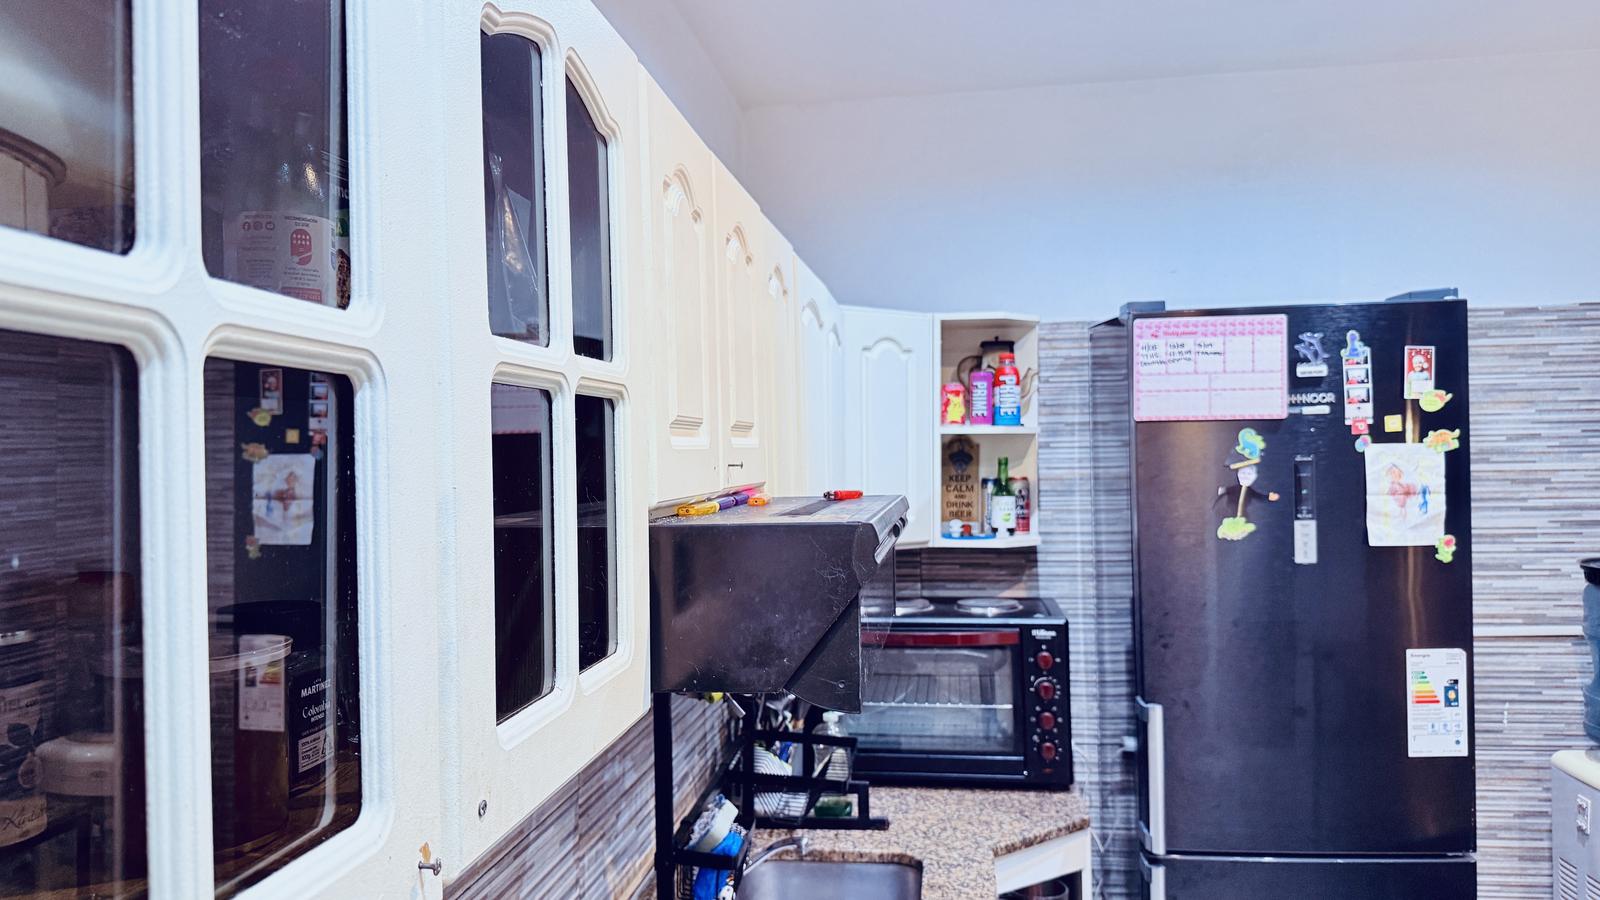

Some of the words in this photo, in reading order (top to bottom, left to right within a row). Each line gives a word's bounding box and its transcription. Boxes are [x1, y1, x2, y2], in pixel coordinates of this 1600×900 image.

[972, 381, 987, 417] PRIME
[999, 374, 1017, 416] PRIME
[949, 474, 971, 483] KEEP
[946, 484, 974, 493] CALM
[946, 501, 974, 509] DRINK
[949, 510, 972, 518] BEER
